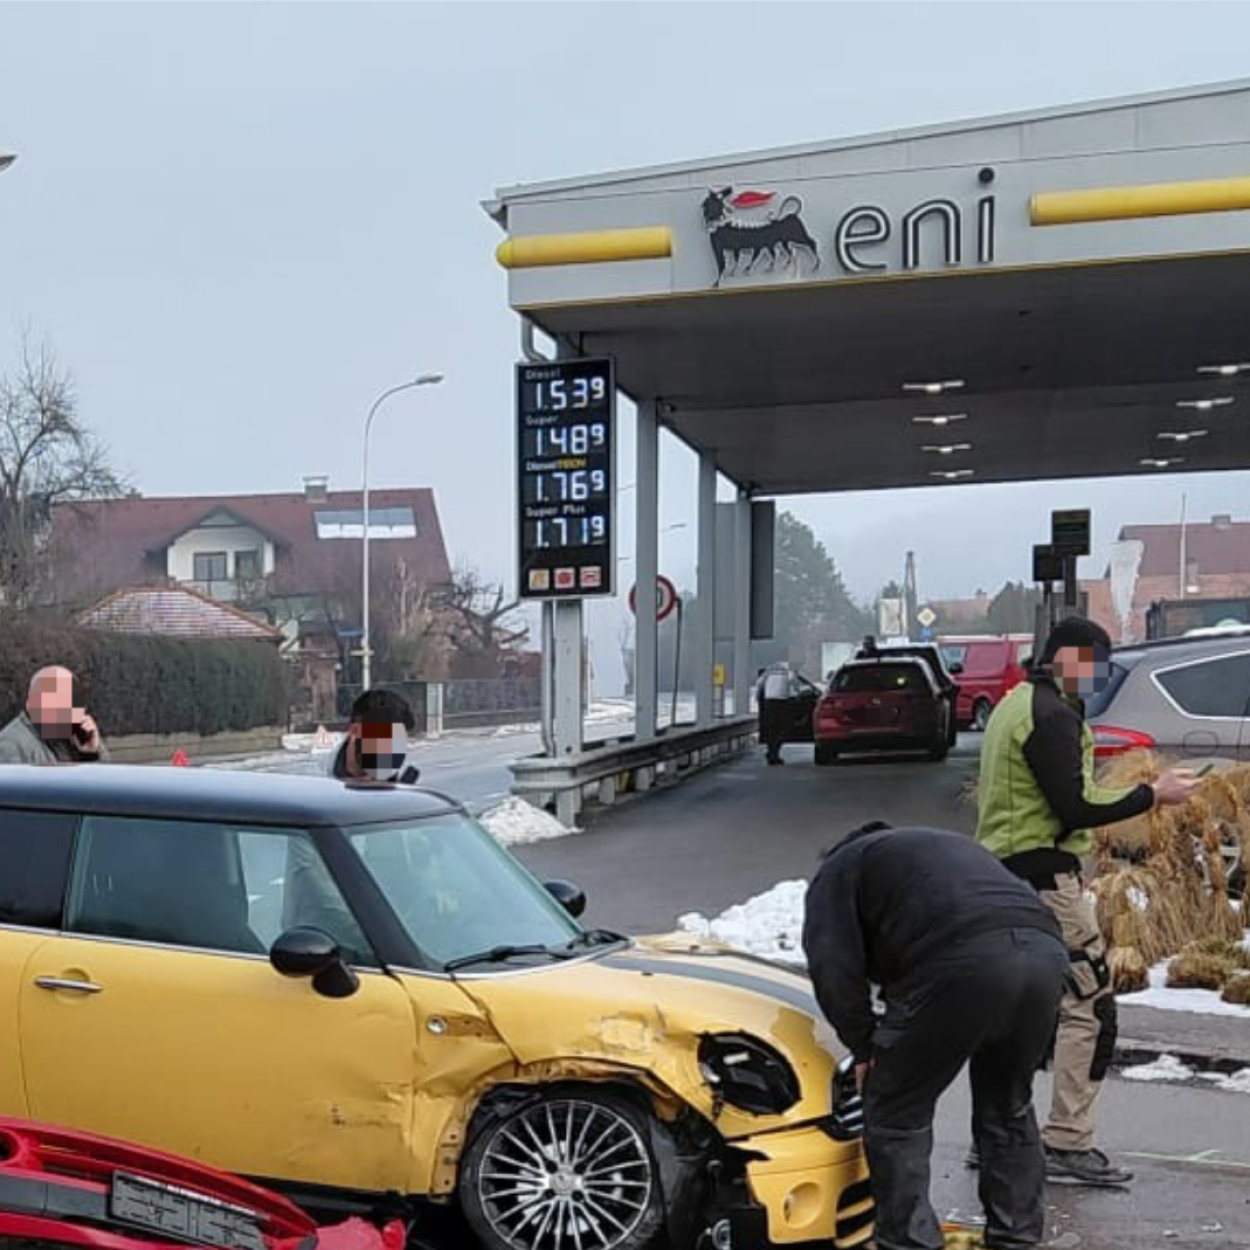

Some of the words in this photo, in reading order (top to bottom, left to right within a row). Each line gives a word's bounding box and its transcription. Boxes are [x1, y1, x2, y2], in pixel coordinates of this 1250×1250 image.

[836, 167, 995, 273] eni
[526, 414, 559, 427] Super
[526, 506, 558, 518] Super
